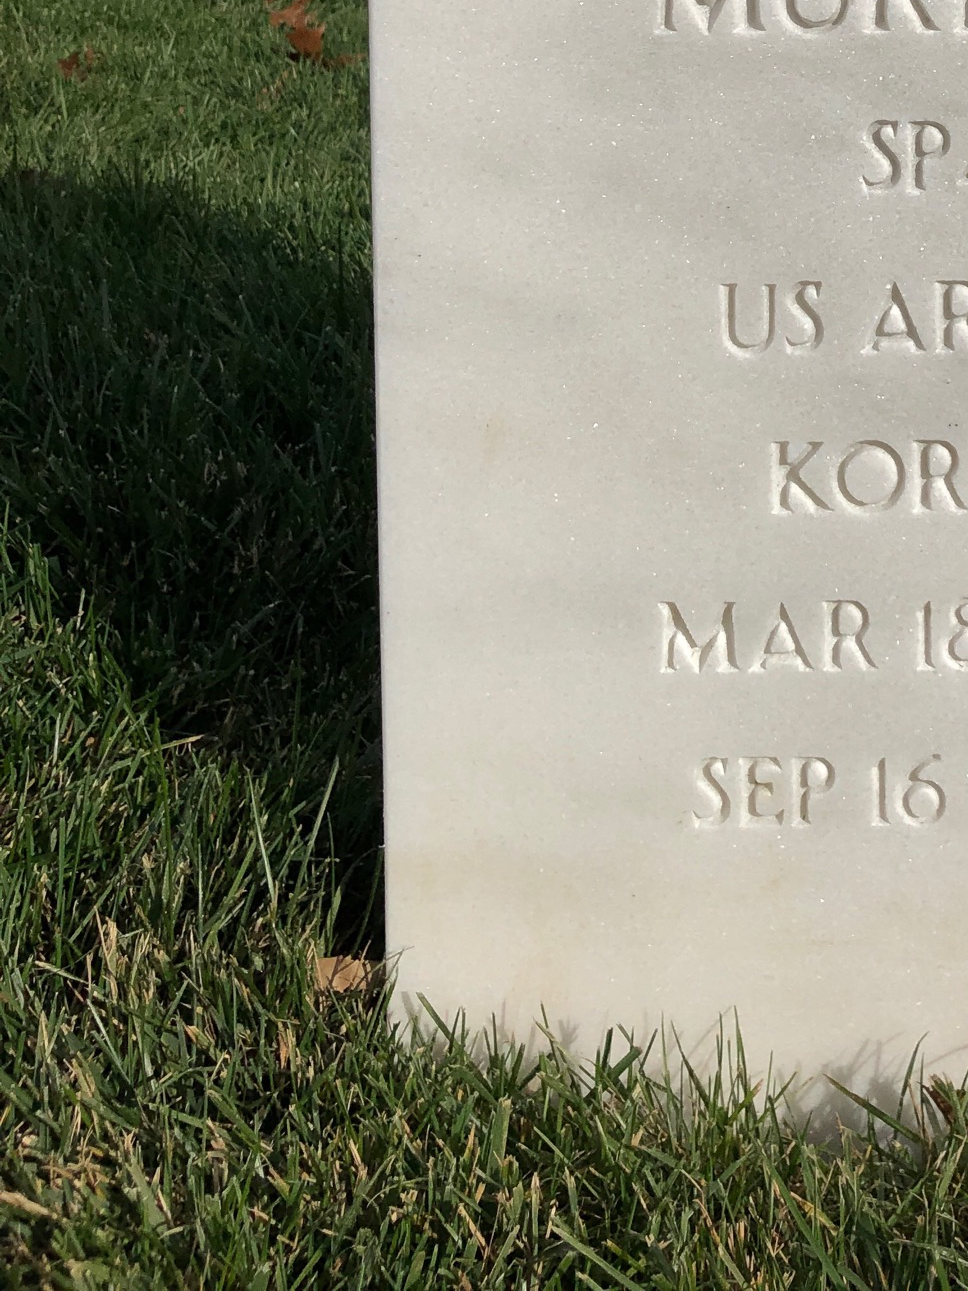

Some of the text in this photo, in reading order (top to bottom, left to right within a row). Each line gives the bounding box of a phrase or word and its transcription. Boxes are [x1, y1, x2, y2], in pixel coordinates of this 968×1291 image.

[718, 280, 826, 356] US
[658, 599, 880, 674] MAR
[691, 755, 836, 829] SEP
[871, 753, 948, 826] 16
